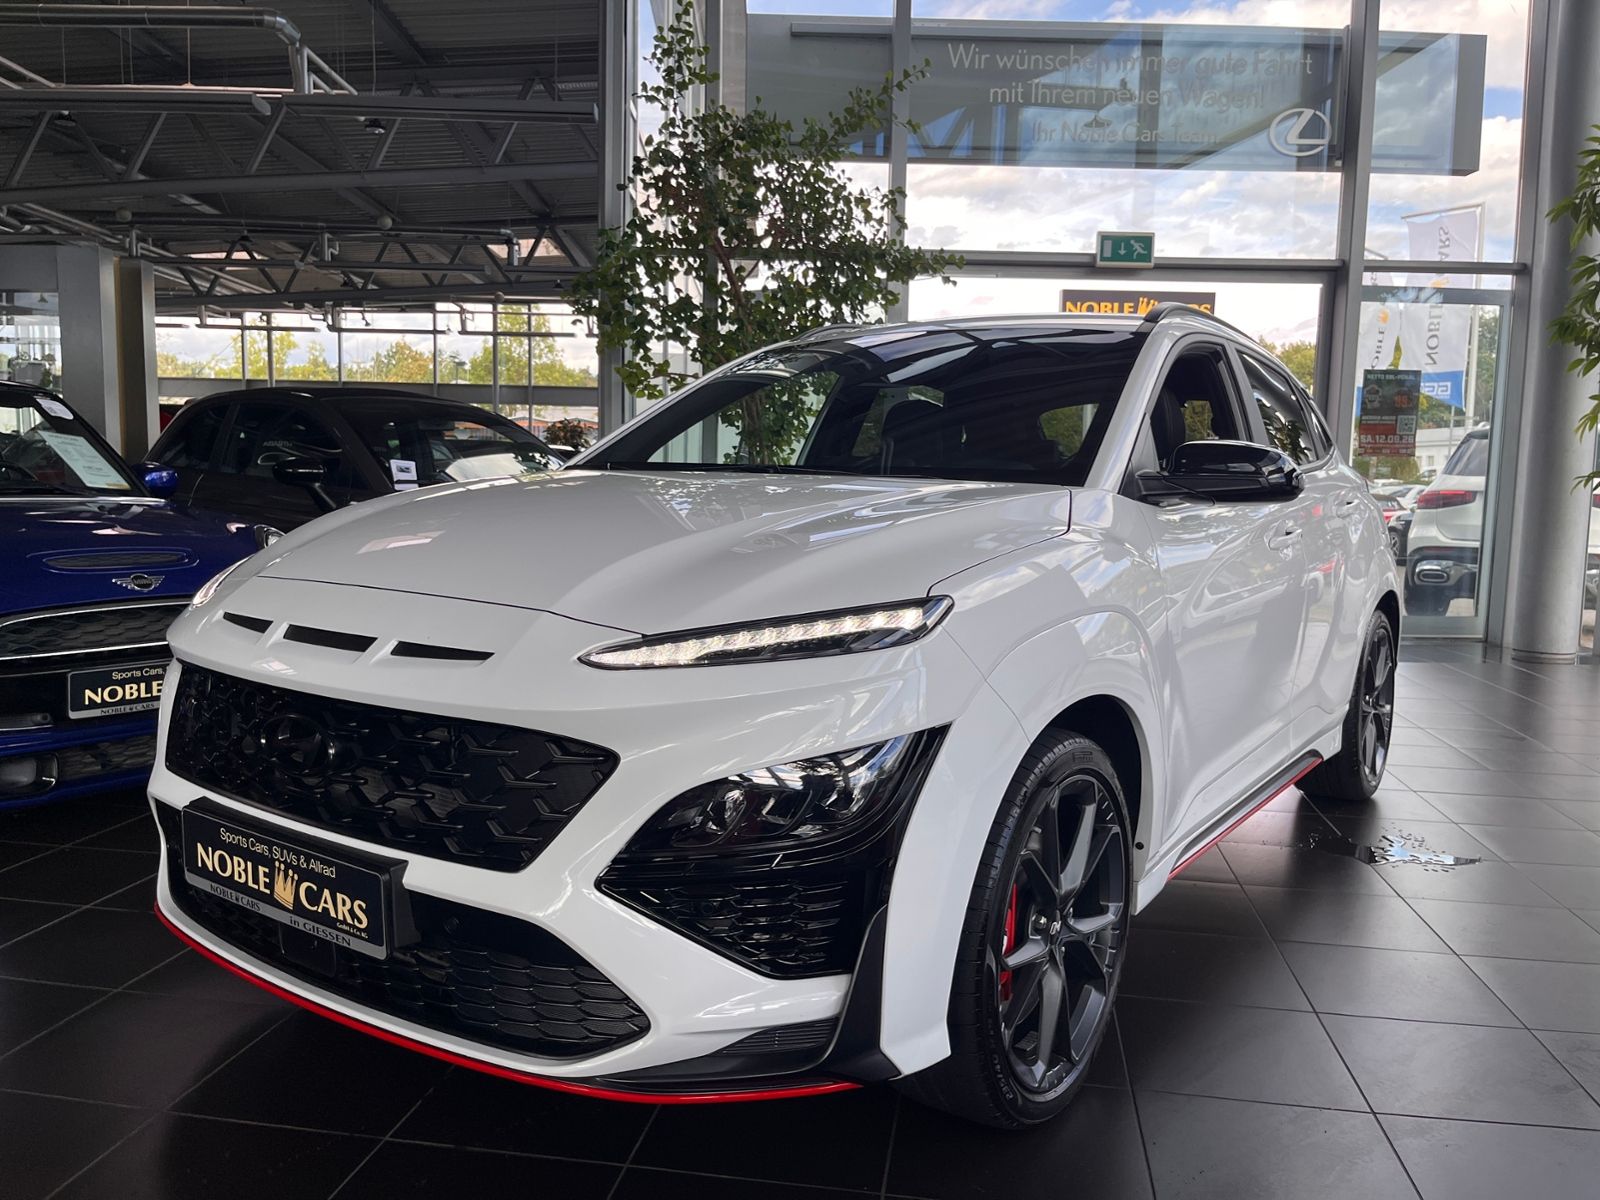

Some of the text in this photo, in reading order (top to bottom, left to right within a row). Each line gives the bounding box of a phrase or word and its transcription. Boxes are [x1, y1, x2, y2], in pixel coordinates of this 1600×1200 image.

[948, 43, 1313, 81] Wir wünschen immer gute Fahrt
[989, 80, 1264, 114] mit Ihrem neuen Wagen!
[1032, 120, 1056, 143] Ihr
[1060, 120, 1118, 144] Noble
[1120, 121, 1165, 144] Cars
[1065, 301, 1135, 314] NOBLE
[112, 670, 141, 680] Sports
[84, 680, 164, 706] NOBLE
[101, 703, 155, 715] NOBLE CARS
[220, 827, 336, 878] Sports Cars, SUVs & Allrad
[196, 842, 368, 929] NOBLE CARS
[210, 883, 261, 912] NOBLE CARS
[289, 916, 351, 947] in GIESSEN
